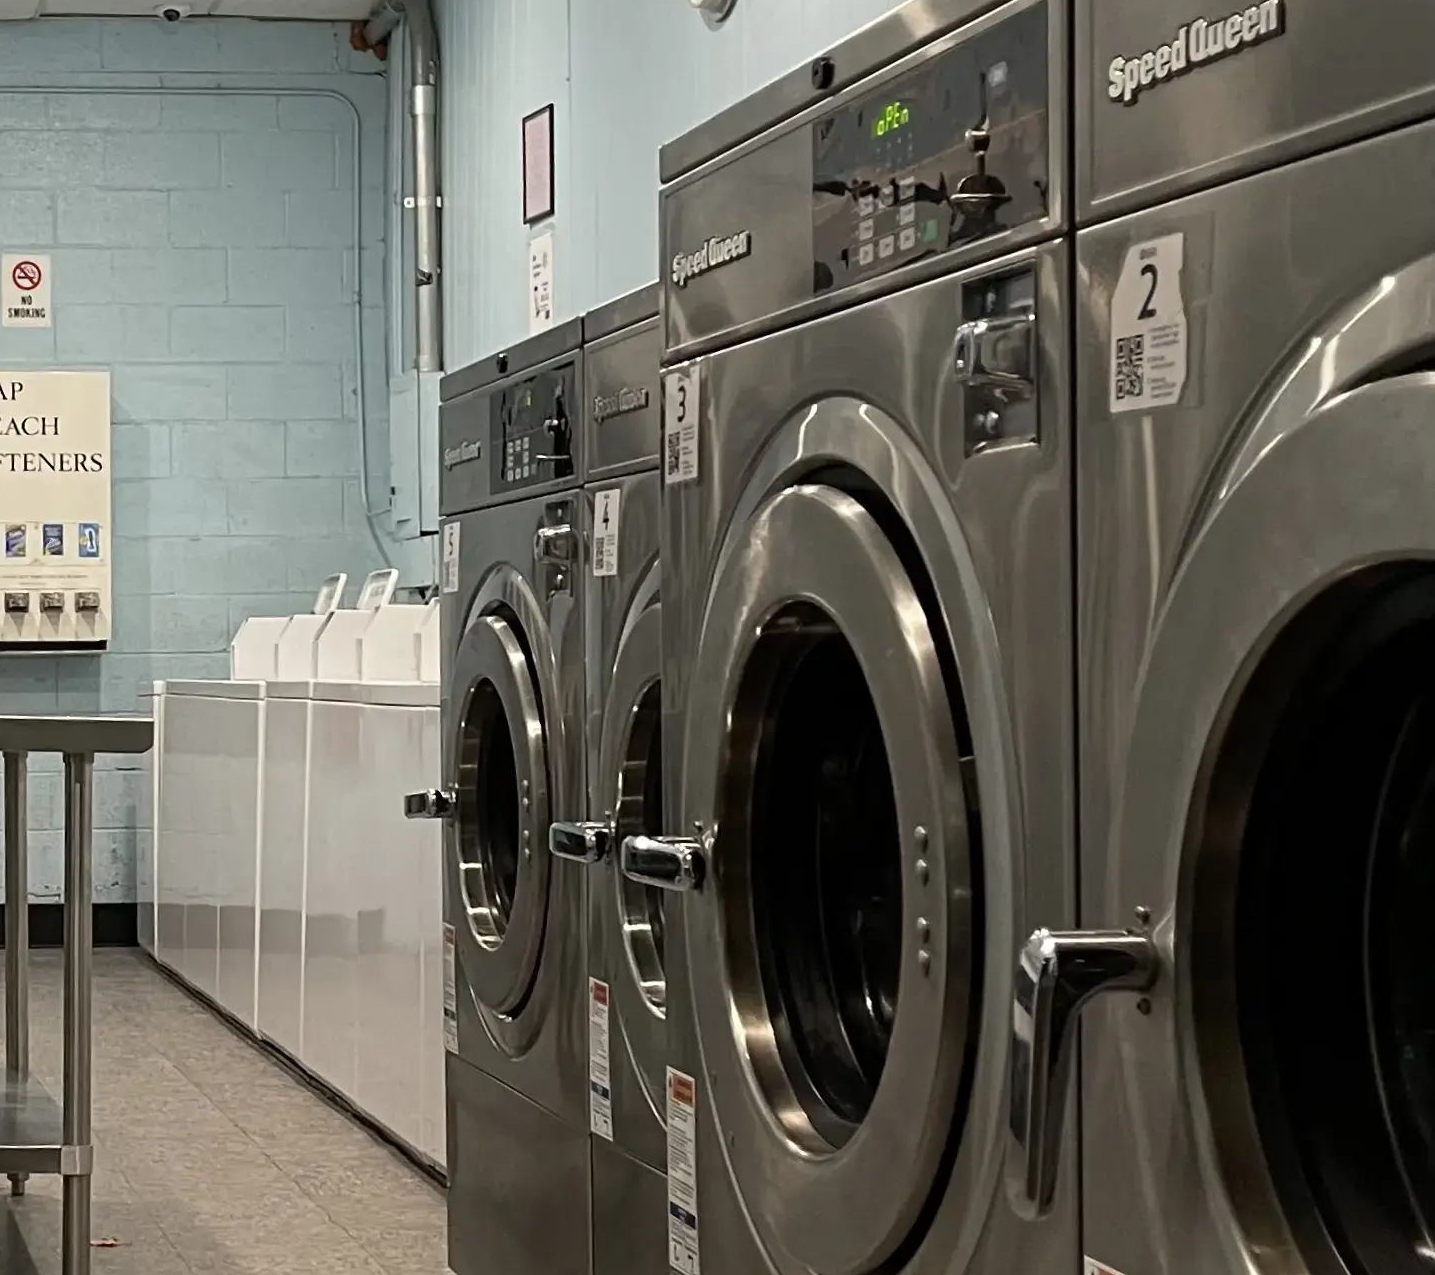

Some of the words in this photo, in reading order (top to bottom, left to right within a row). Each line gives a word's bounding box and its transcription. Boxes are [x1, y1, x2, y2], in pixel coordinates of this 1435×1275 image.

[1108, 25, 1187, 102] Speed
[672, 240, 708, 286] Speed
[708, 230, 750, 266] Queen
[7, 307, 46, 319] SMOKING
[20, 294, 33, 306] NO
[1136, 263, 1159, 321] 2
[676, 384, 687, 423] 3
